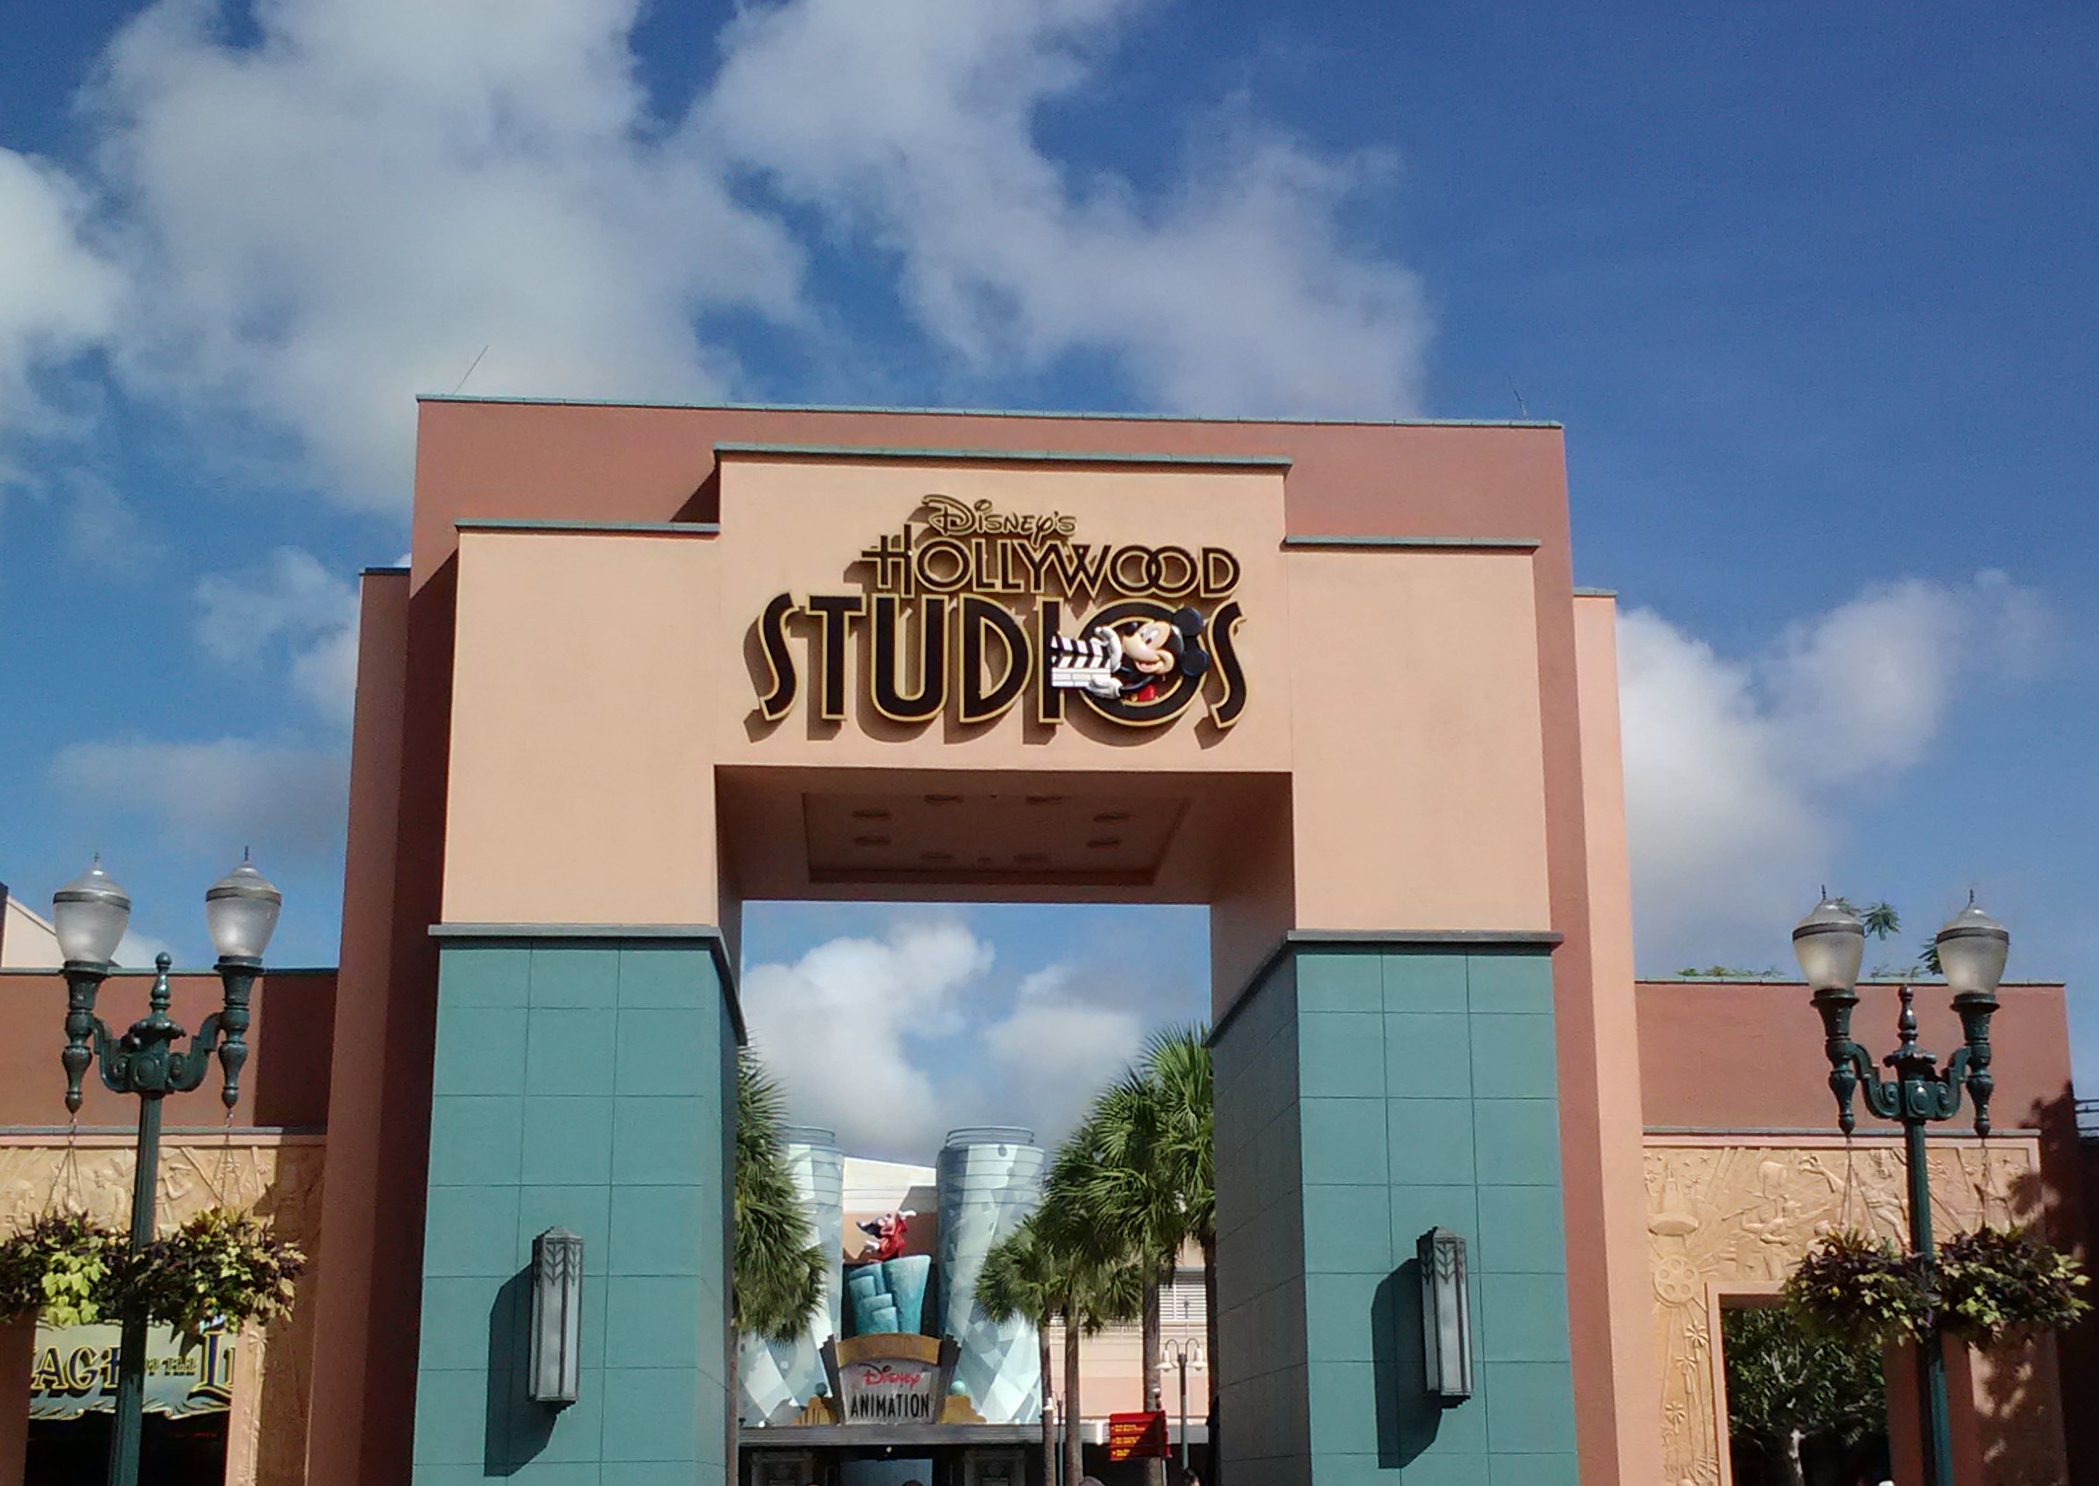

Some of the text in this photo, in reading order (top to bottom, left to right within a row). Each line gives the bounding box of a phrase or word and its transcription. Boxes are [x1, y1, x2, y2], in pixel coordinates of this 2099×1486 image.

[861, 523, 1242, 599] HOLLYWOOD
[758, 592, 1248, 729] STUDIOS
[859, 1363, 920, 1389] Disney
[850, 1393, 930, 1418] ANIMATION
